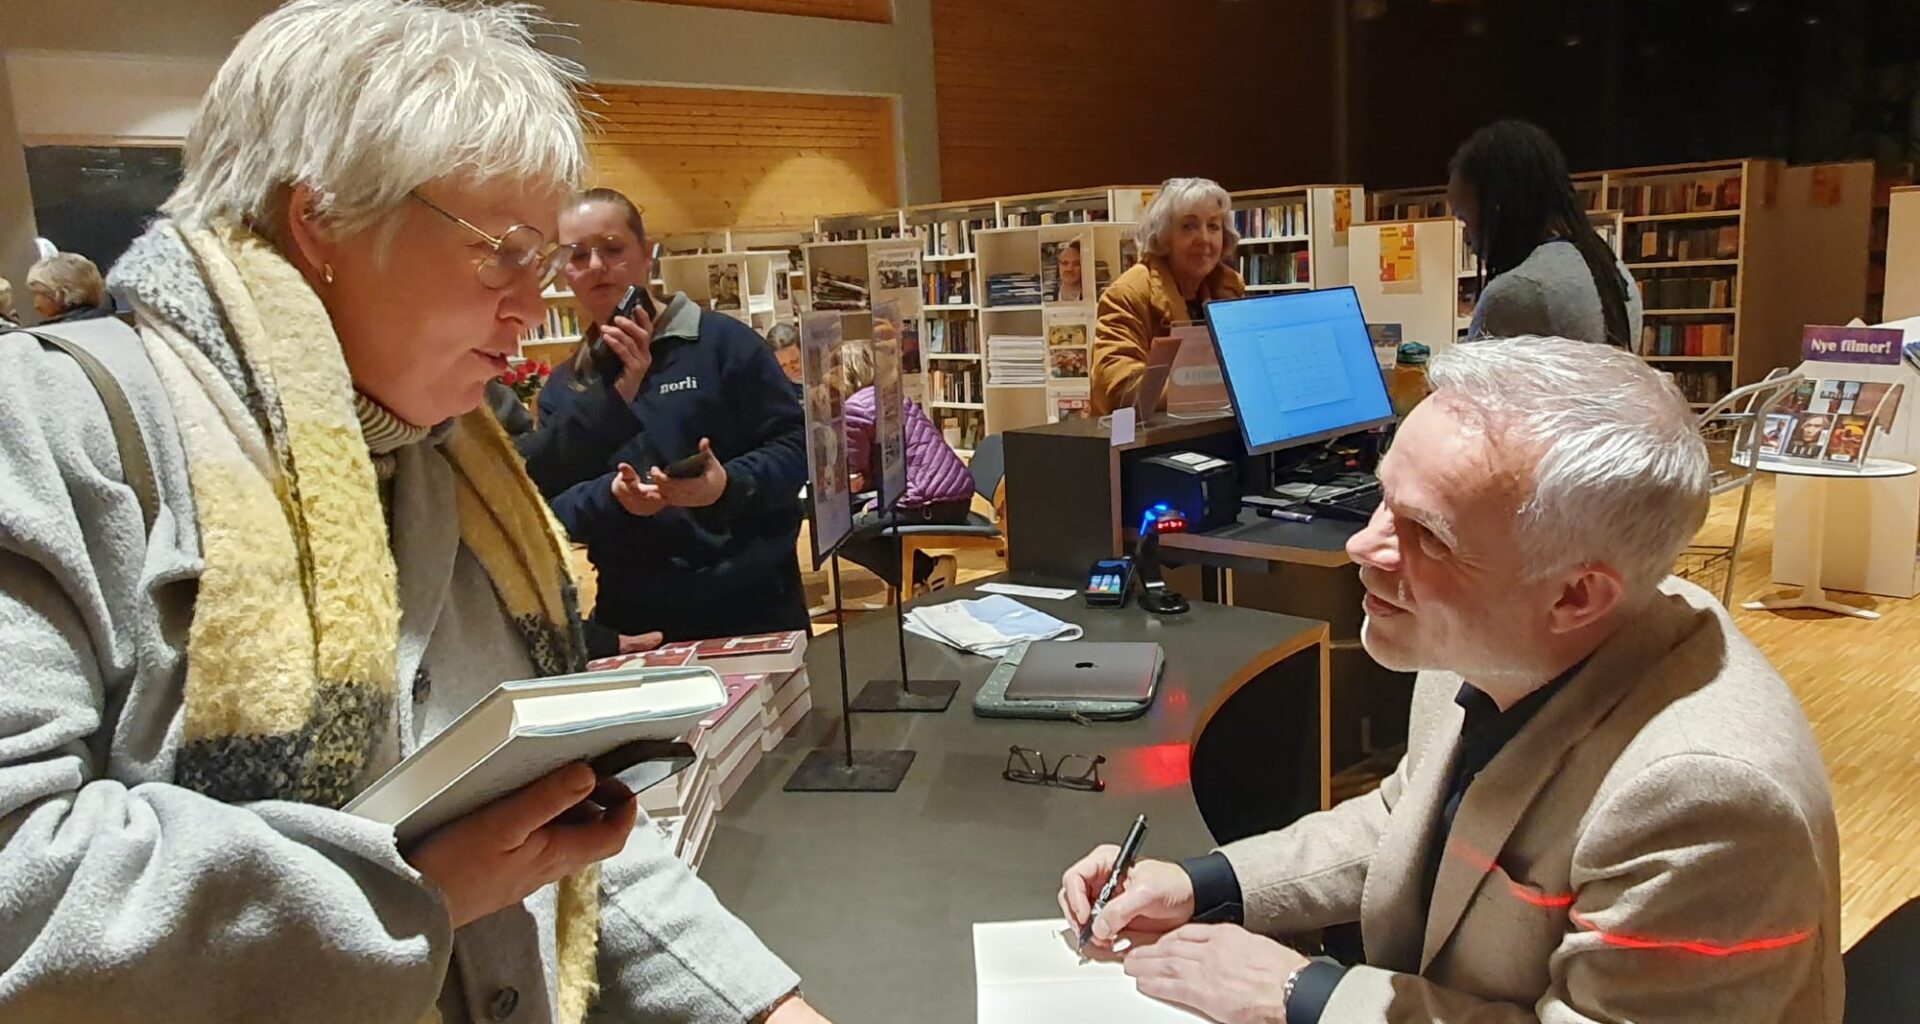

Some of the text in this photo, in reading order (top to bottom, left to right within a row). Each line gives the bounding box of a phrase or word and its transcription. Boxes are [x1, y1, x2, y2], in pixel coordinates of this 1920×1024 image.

[1811, 338, 1892, 354] Nye filmer!
[660, 376, 697, 394] norli
